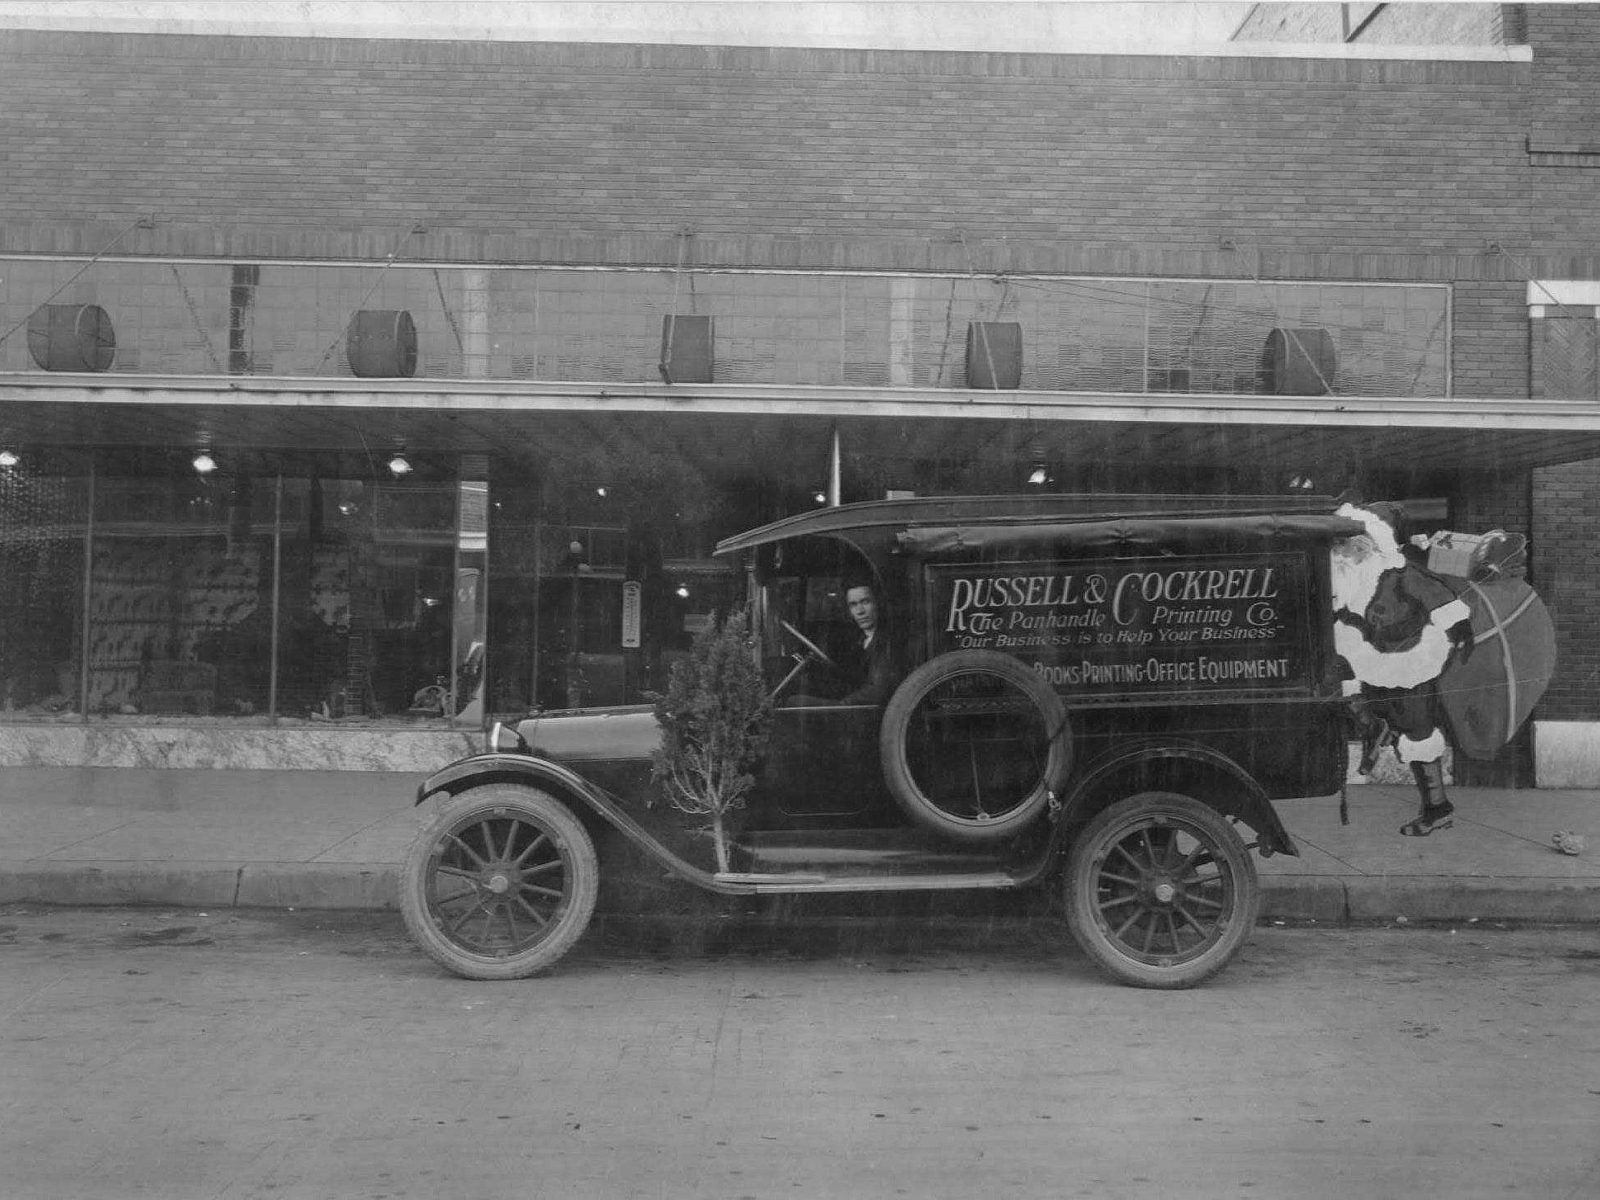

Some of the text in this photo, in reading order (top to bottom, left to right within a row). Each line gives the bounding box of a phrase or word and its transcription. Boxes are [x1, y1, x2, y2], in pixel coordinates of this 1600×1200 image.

[945, 568, 1279, 632] RUSSELL & COCKRELL
[968, 602, 1279, 635] The Panhandle Printing Co.
[996, 633, 1071, 647] Business
[1077, 631, 1092, 645] is
[1096, 630, 1114, 645] to
[1117, 629, 1153, 645] Help
[1158, 628, 1199, 642] Your
[1199, 656, 1288, 683] EQUIPMENT
